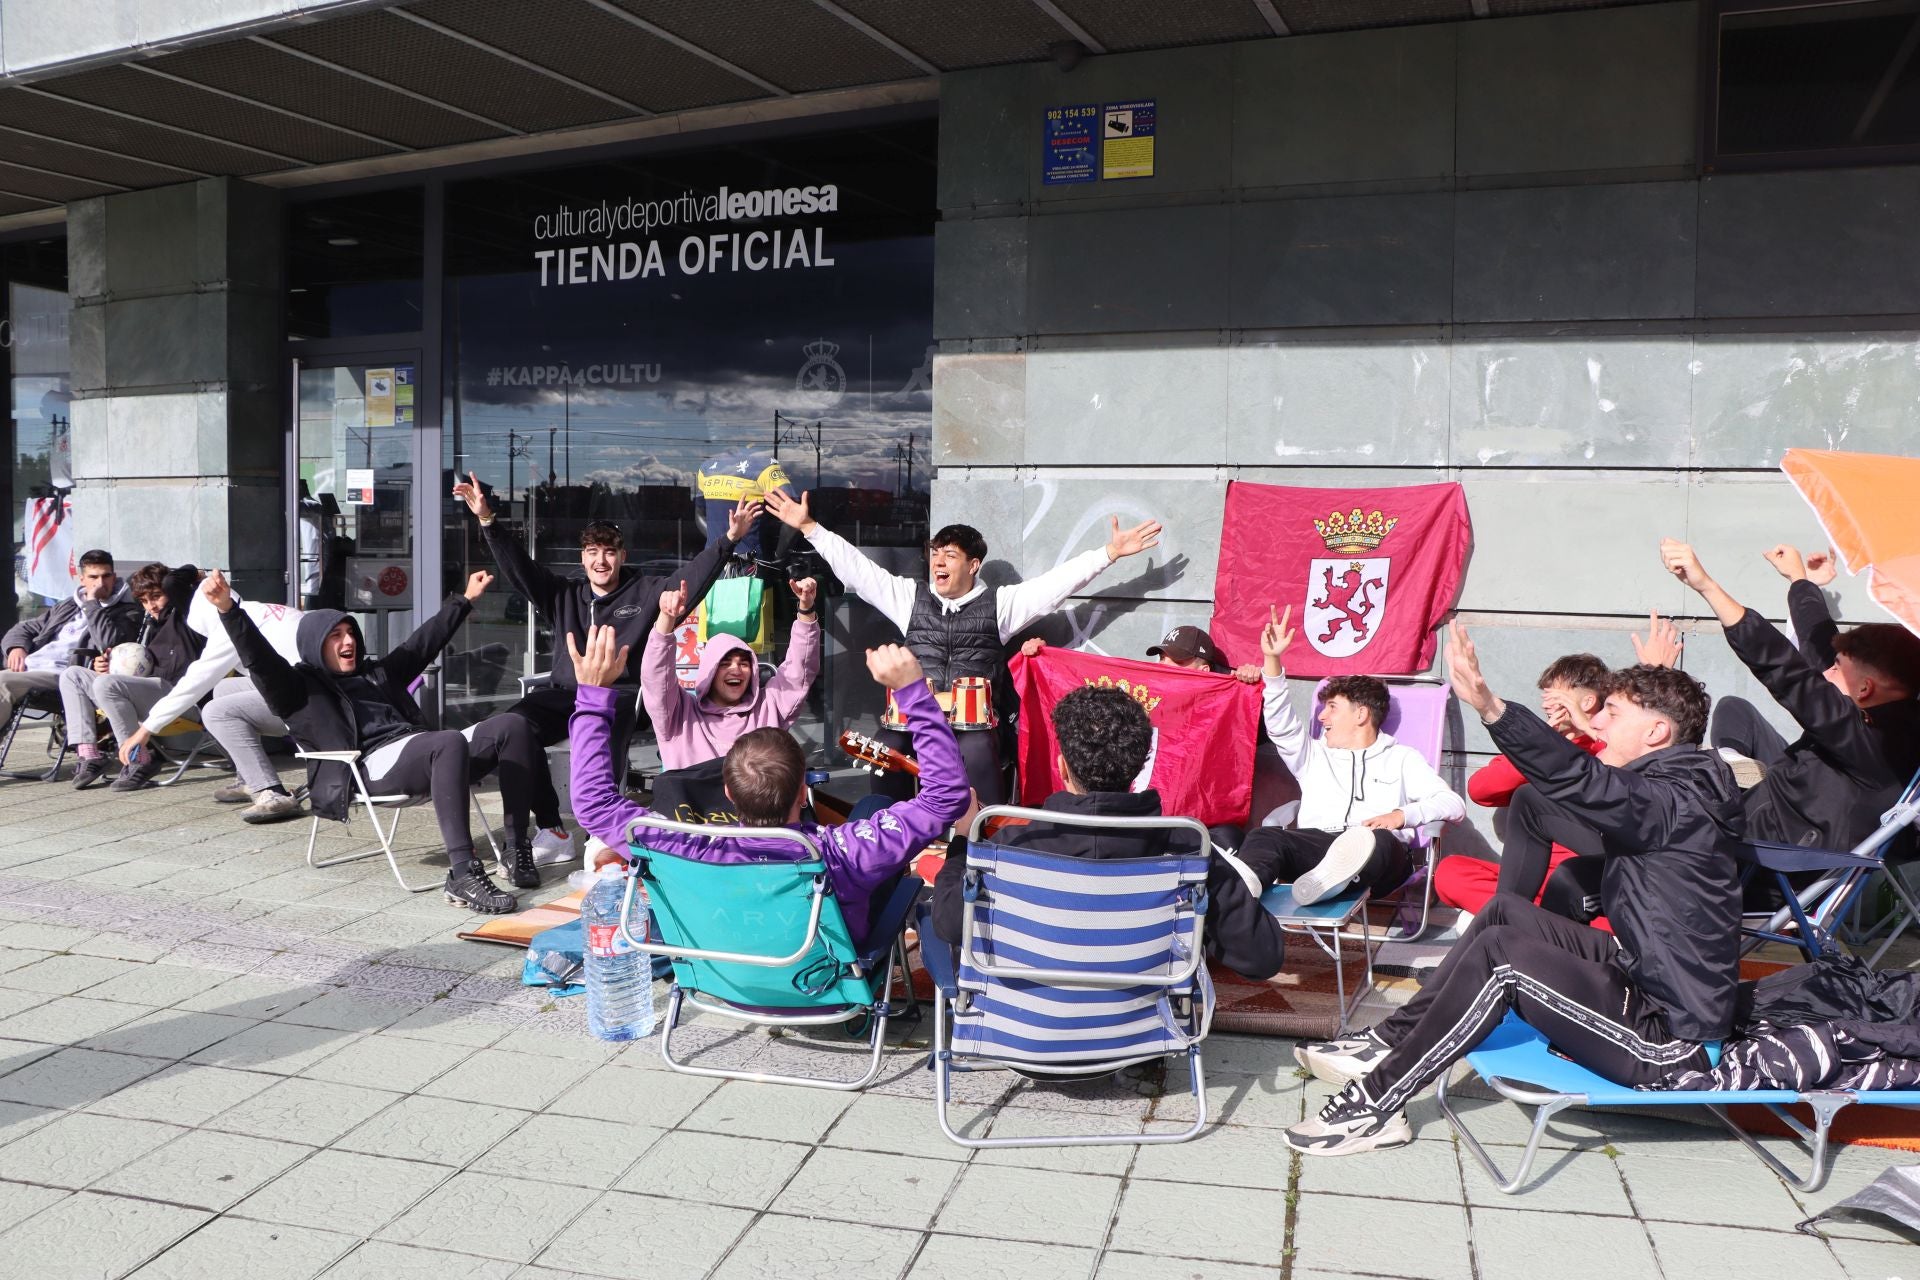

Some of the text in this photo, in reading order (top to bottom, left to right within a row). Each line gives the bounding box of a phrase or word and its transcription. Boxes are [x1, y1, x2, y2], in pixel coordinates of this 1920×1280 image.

[1047, 107, 1096, 120] 902 154 539
[535, 227, 835, 287] TIENDA OFICIAL
[486, 363, 661, 387] #KAPPA4CULTU
